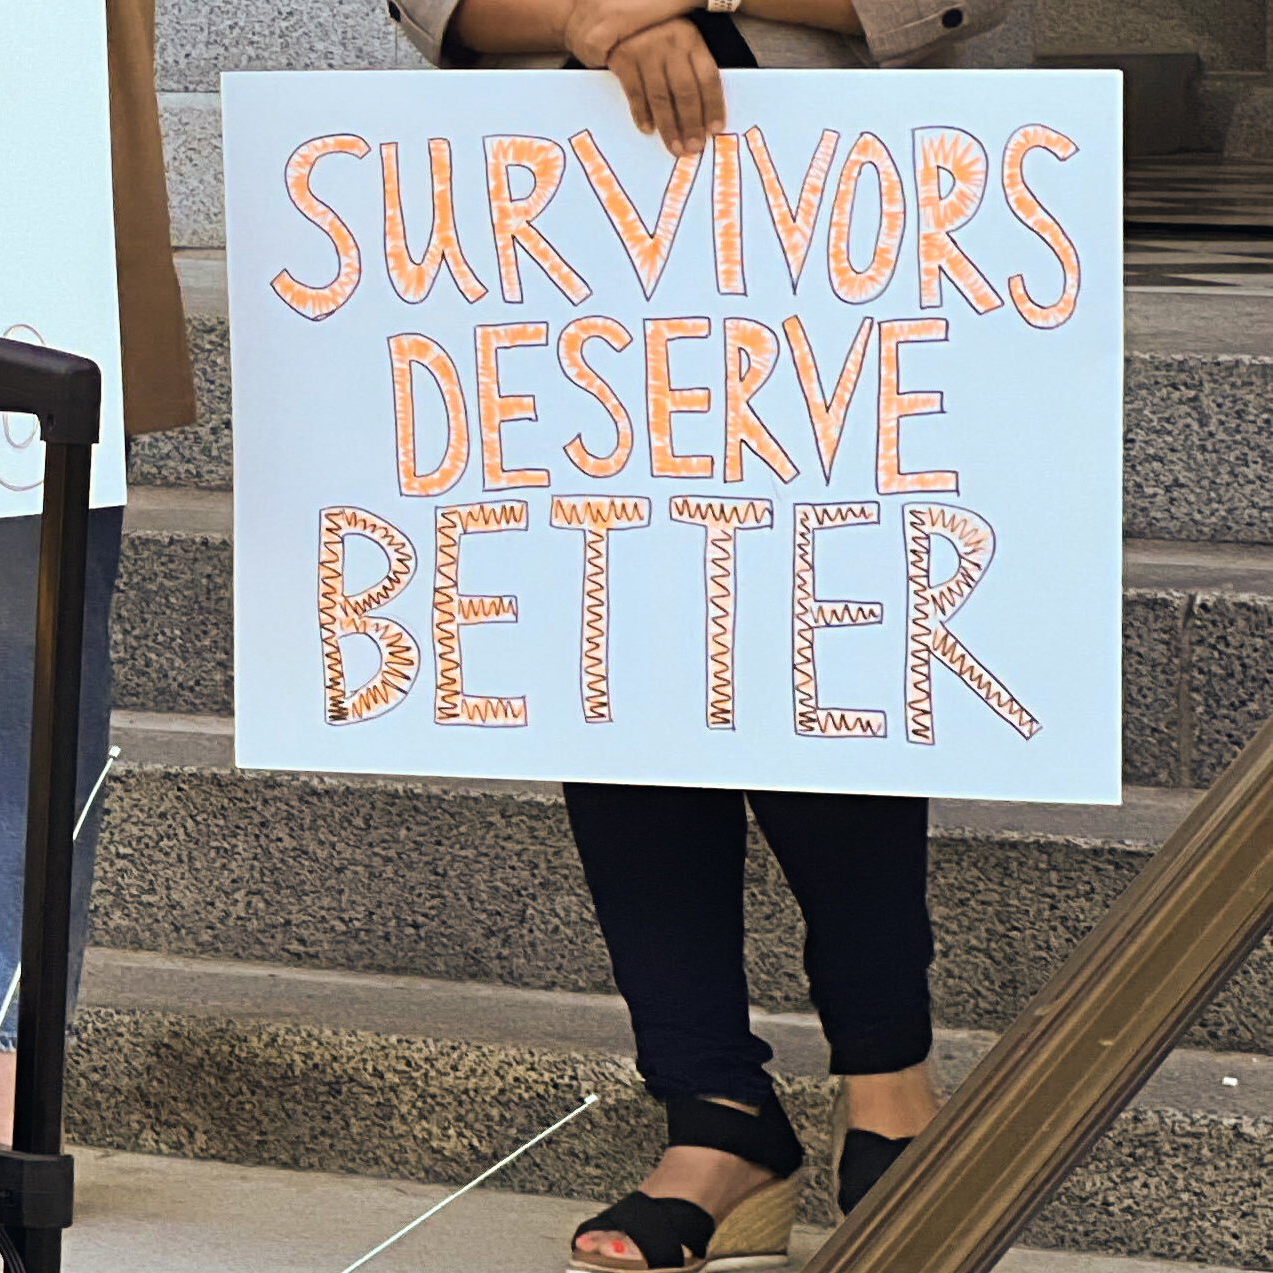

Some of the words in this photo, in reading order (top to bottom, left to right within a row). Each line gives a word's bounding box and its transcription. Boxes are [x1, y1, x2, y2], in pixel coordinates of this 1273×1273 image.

[270, 124, 1081, 330] SURVIVORS
[387, 315, 960, 496] DESERVE
[316, 495, 1043, 745] BETTER
